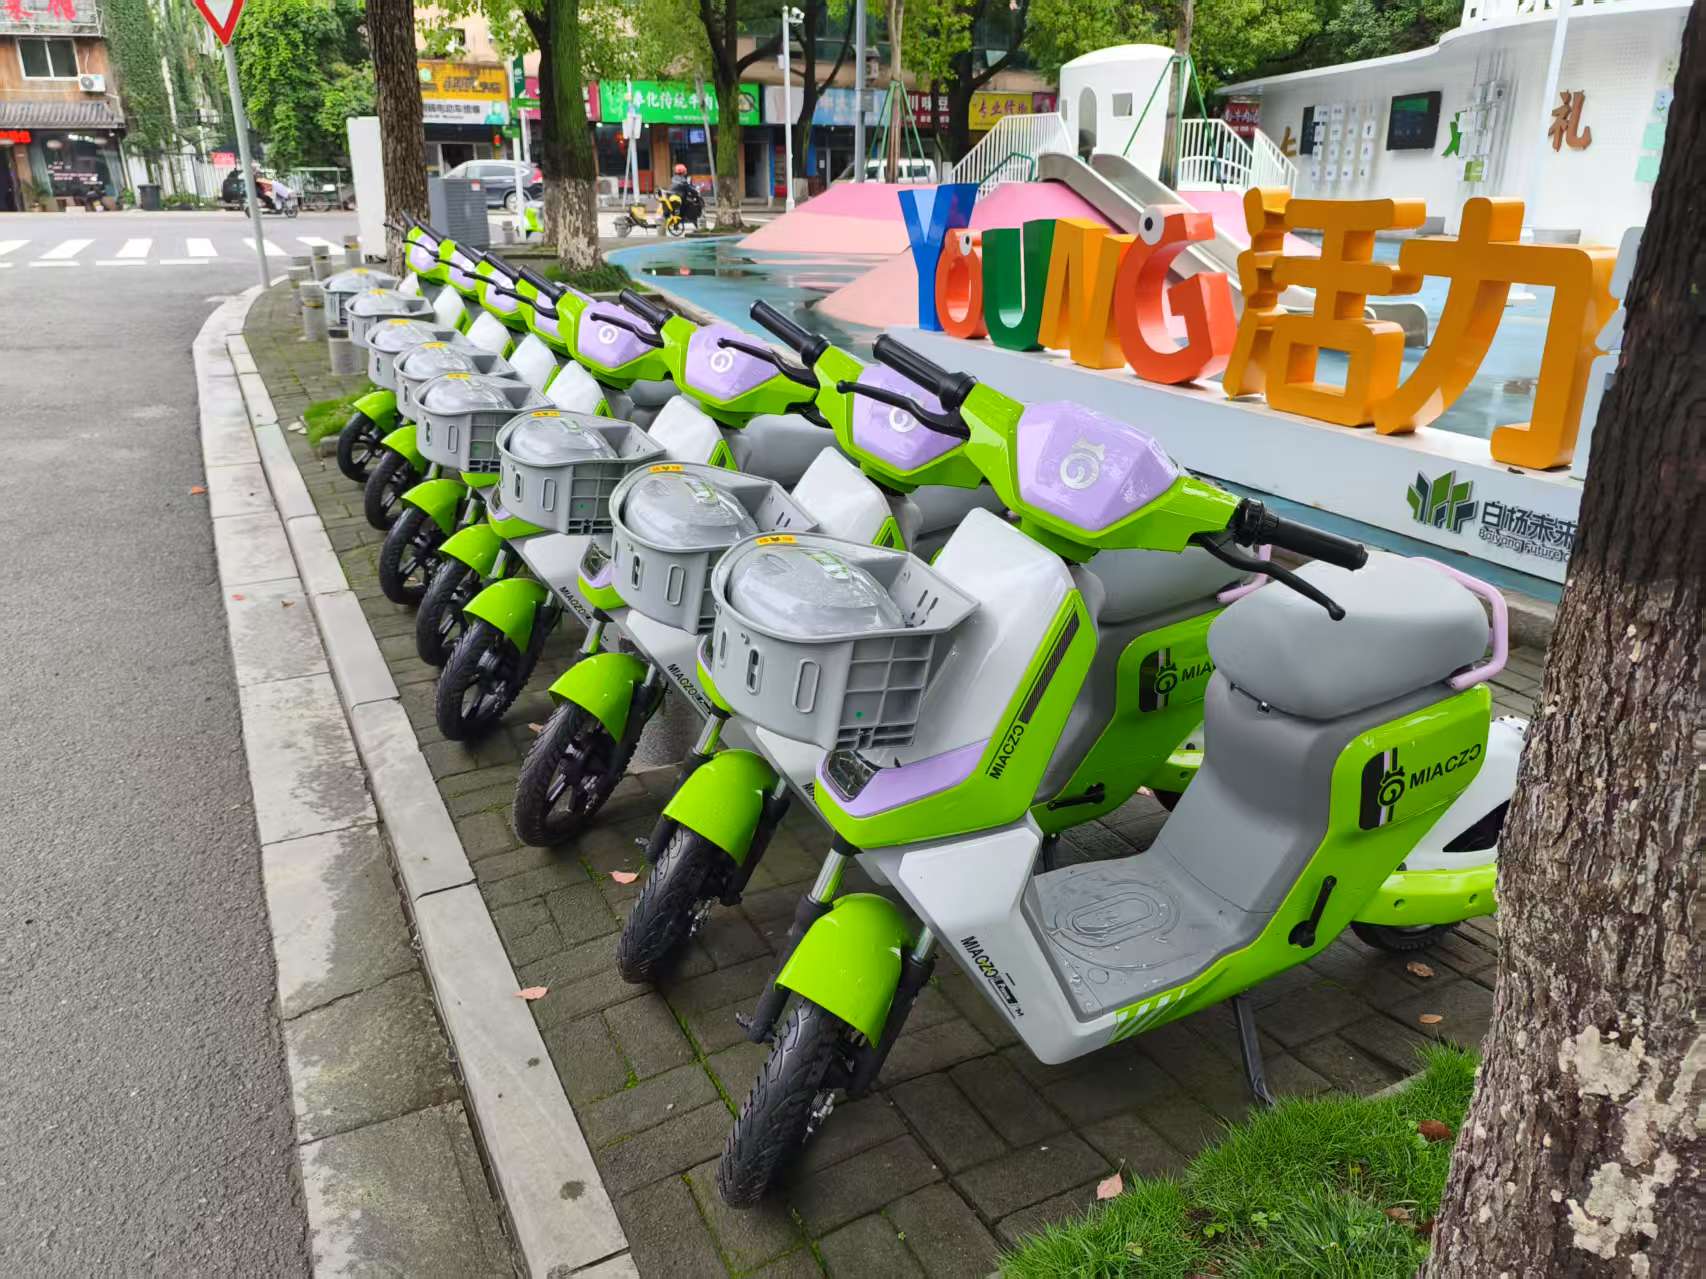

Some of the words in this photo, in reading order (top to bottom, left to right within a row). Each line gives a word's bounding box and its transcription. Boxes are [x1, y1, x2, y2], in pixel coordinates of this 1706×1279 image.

[1548, 90, 1592, 151] 礼
[898, 183, 1236, 384] YOUNG
[1223, 186, 1618, 469] 活力
[1478, 528, 1522, 554] Baiyang
[1523, 541, 1563, 562] Future
